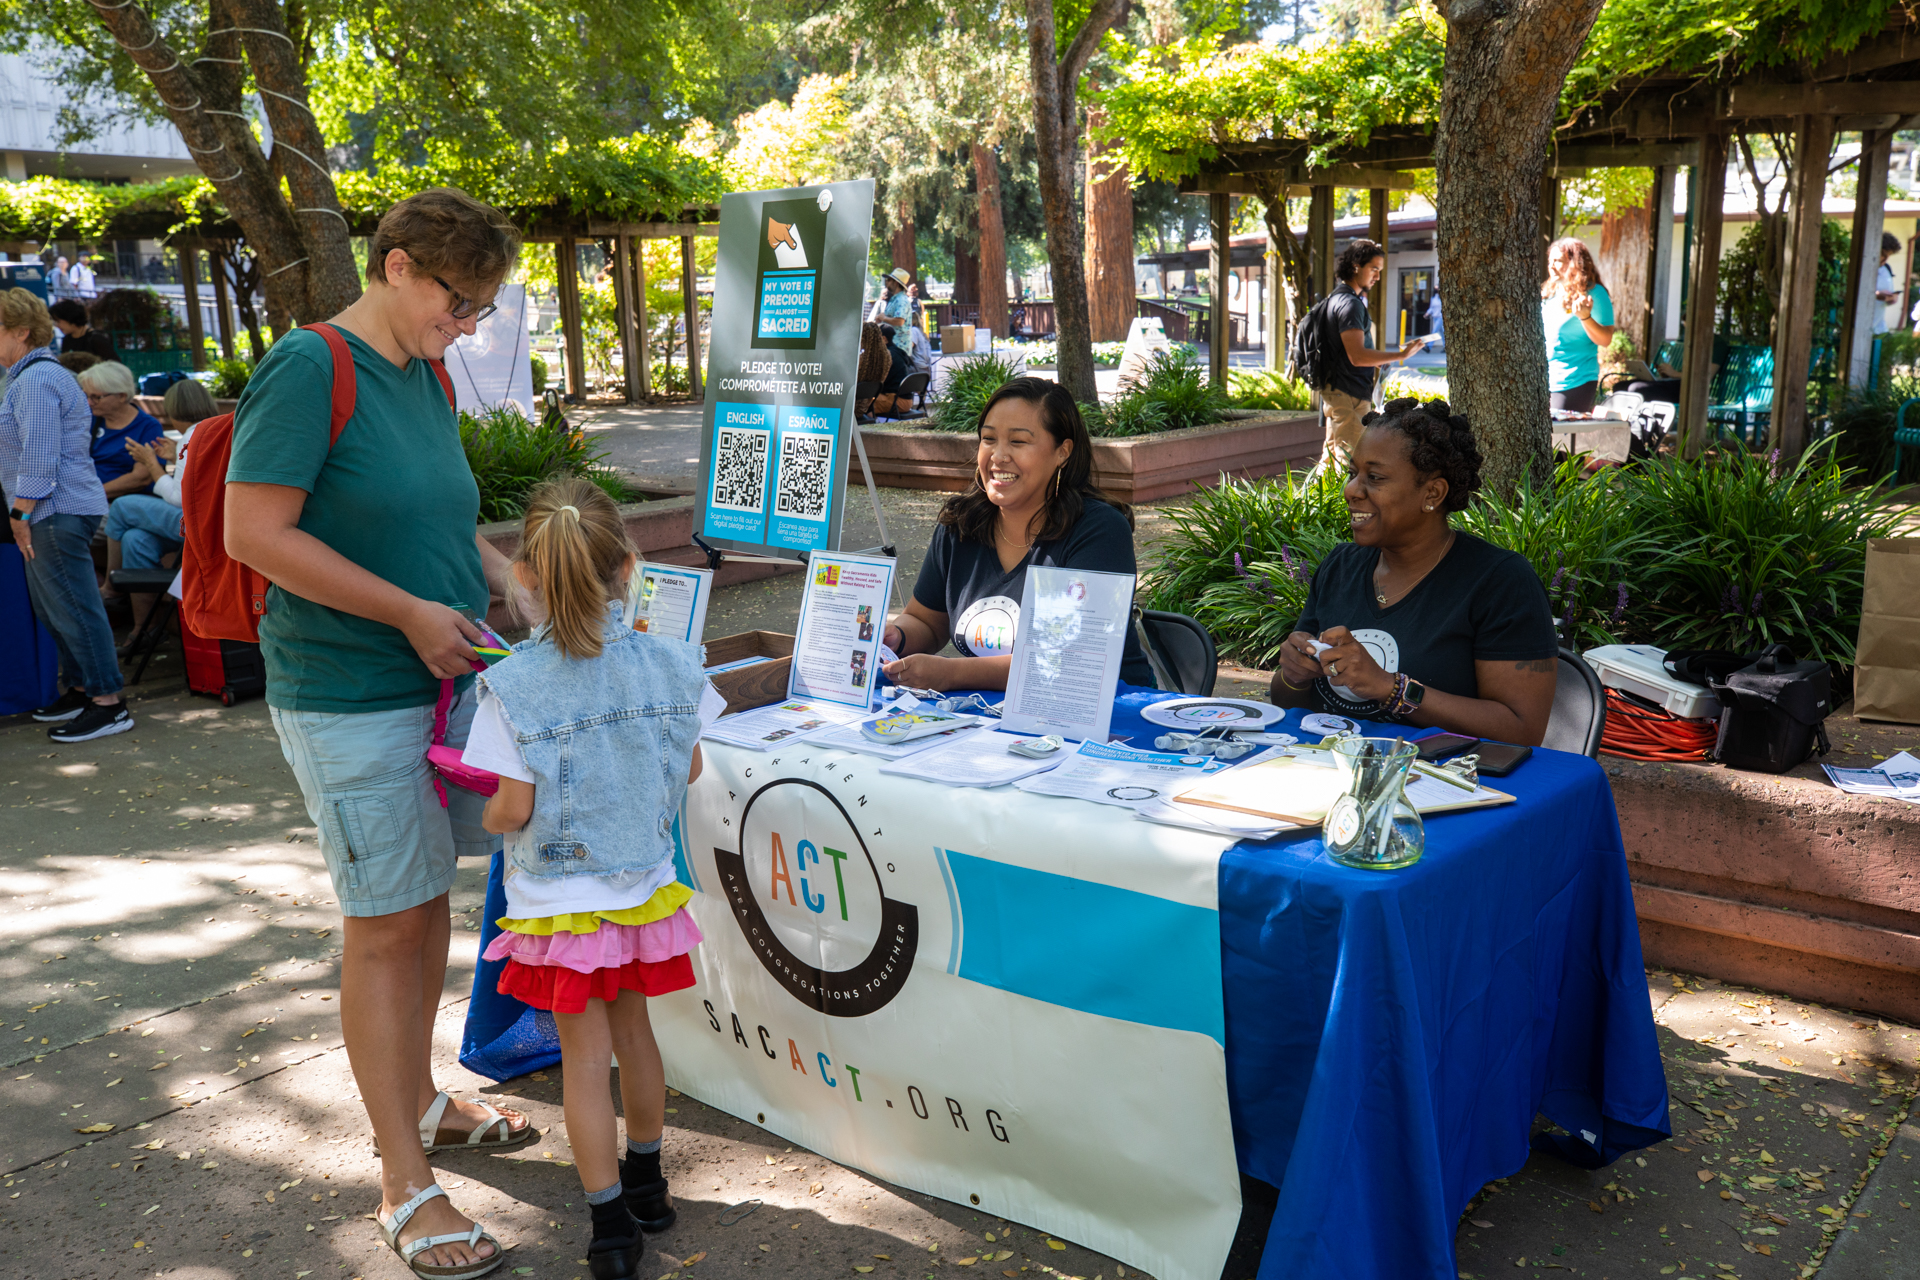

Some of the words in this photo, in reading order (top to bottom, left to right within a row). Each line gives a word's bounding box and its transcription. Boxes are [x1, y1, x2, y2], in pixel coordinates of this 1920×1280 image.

[765, 282, 777, 291] MY
[780, 281, 801, 291] VOTE
[804, 280, 812, 290] IS
[740, 361, 777, 374] PLEDGE
[779, 363, 792, 375] TO
[794, 363, 822, 376] VOTE!
[719, 378, 798, 394] ¡COMPROMÉTETE
[800, 382, 807, 394] A
[809, 382, 843, 396] VOTAR!
[727, 412, 765, 425] ENGLISH
[788, 414, 829, 429] ESPAÑOL
[714, 520, 727, 528] digital
[728, 522, 744, 531] pledge
[974, 624, 1006, 650] ACT
[1185, 709, 1234, 719] ACT
[1082, 748, 1137, 760] CONGREGATIONS
[1086, 743, 1130, 756] SACRAMENTO
[723, 758, 895, 873] SACRAMENTO
[1338, 814, 1354, 838] ACT
[771, 832, 848, 922] ACT
[727, 874, 748, 917] AREA
[752, 927, 860, 1000] CONGREGATIONS
[866, 924, 905, 992] TOGETHER
[703, 999, 1010, 1144] SACACT.ORG
